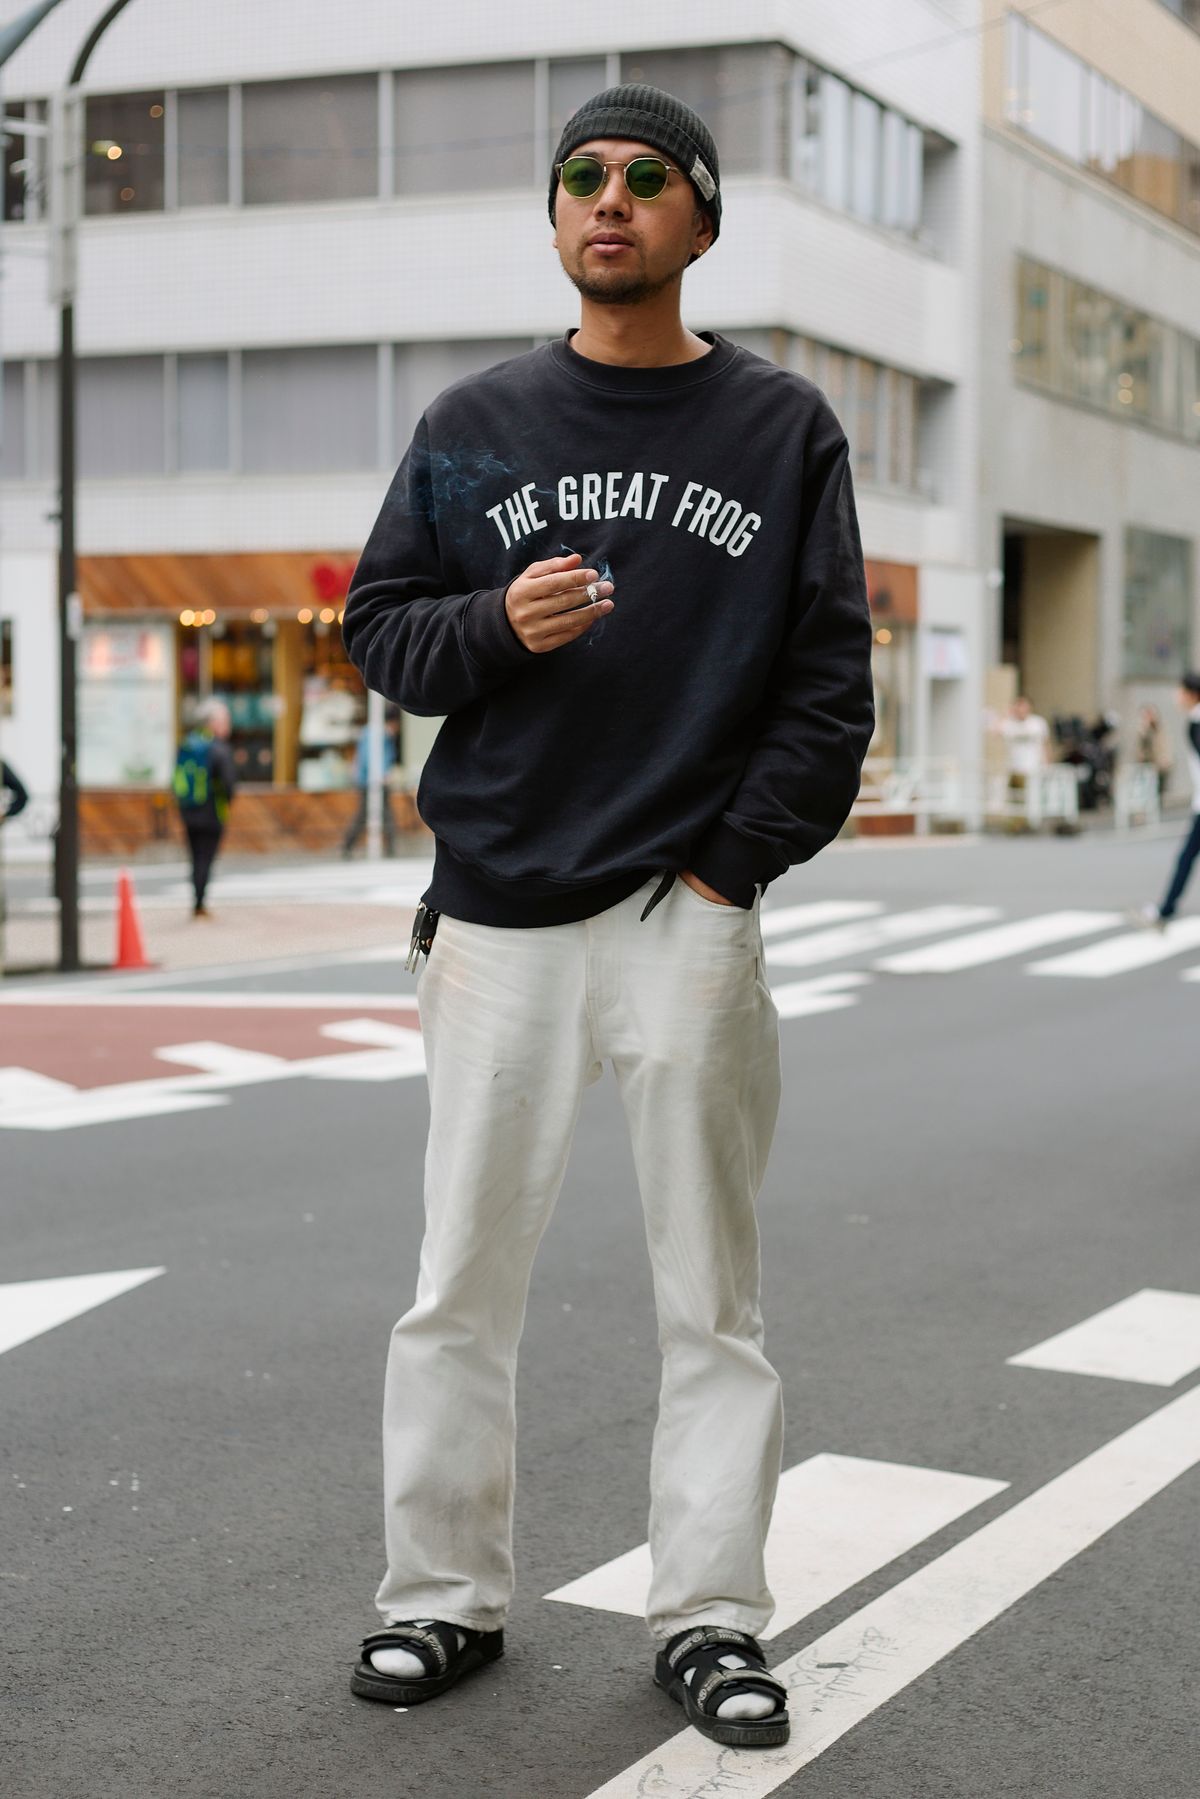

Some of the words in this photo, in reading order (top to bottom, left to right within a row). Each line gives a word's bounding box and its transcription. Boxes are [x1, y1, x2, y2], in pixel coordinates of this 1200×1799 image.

[485, 482, 548, 550] THE
[557, 472, 669, 521] GREAT
[671, 481, 762, 558] FROG
